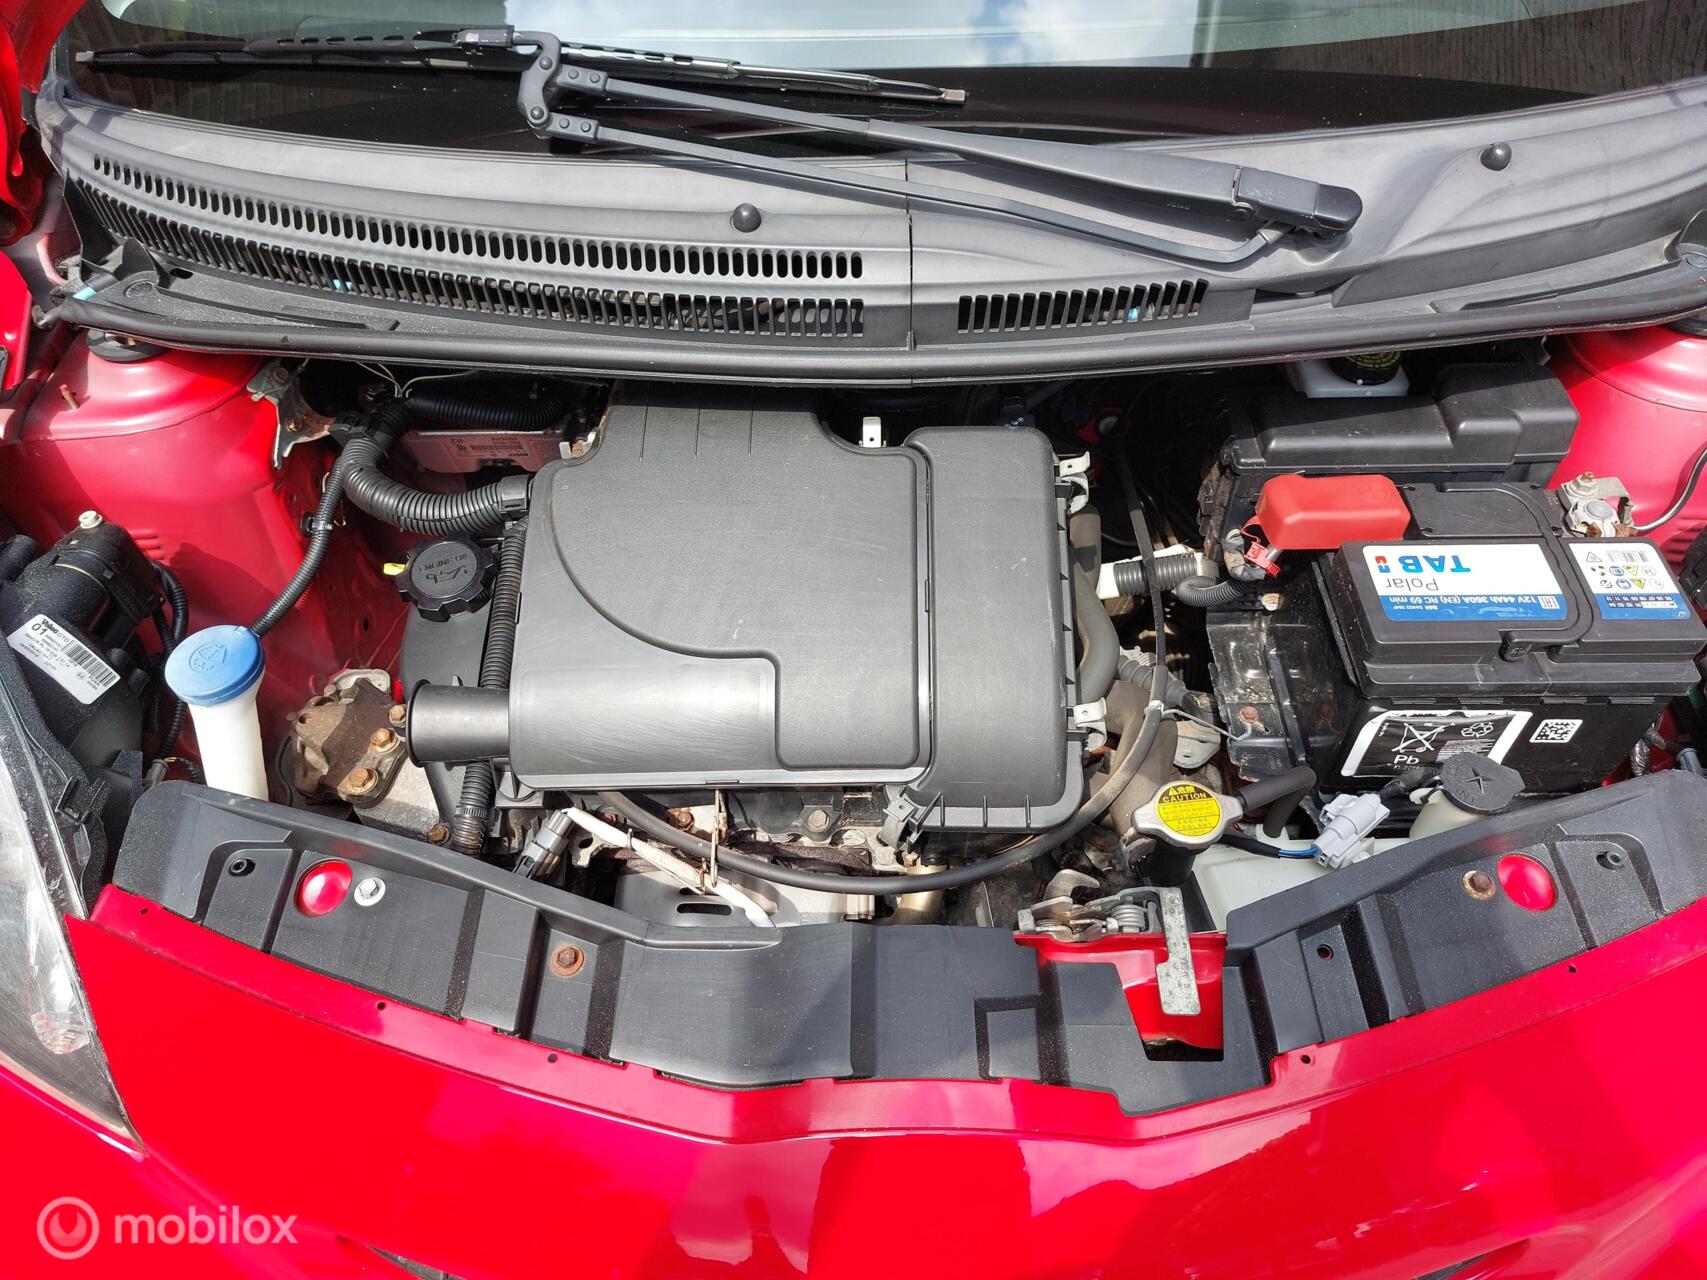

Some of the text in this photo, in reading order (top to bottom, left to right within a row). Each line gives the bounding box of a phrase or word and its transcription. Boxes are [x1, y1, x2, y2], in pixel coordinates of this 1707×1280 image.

[1398, 555, 1471, 573] TAB
[1385, 577, 1439, 592] Polar
[1389, 596, 1408, 604] min
[1423, 596, 1439, 604] RC
[1440, 596, 1461, 605] (EN)
[31, 623, 48, 636] 01
[1393, 754, 1419, 764] Pb
[1163, 792, 1207, 802] CAUTION
